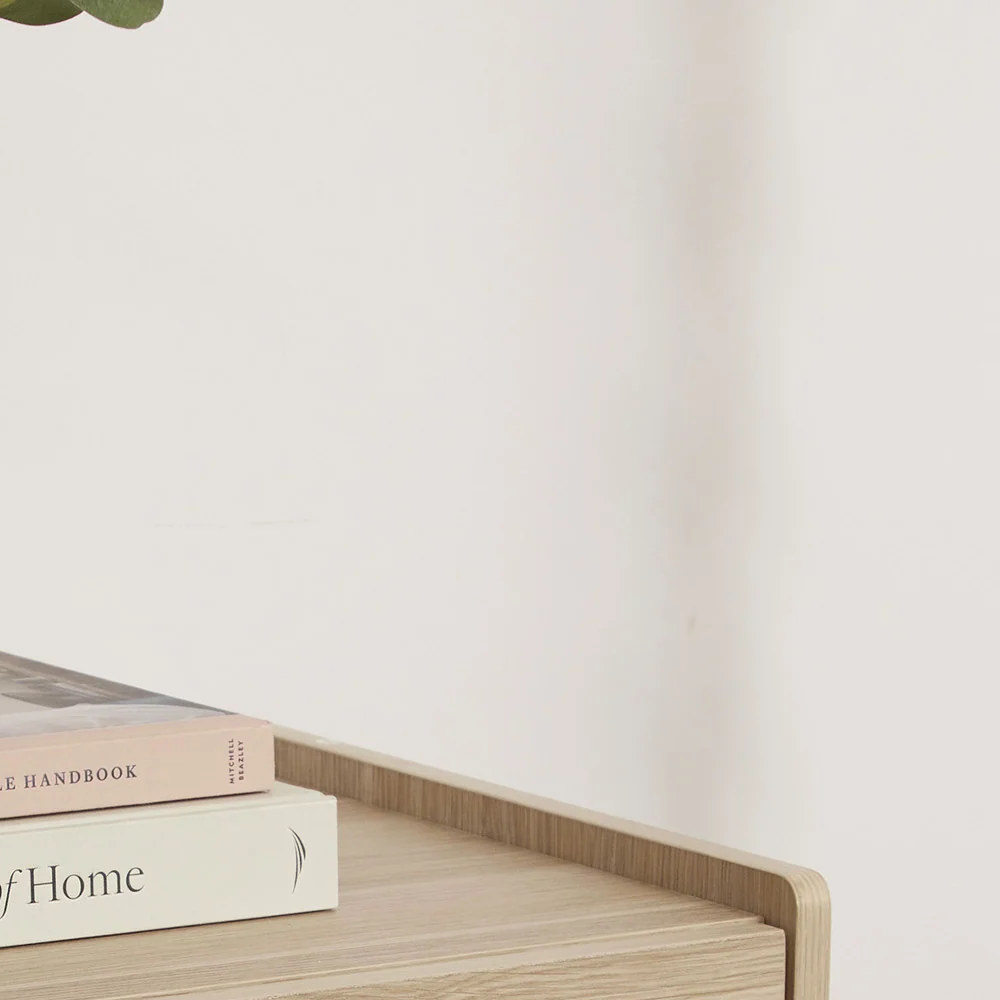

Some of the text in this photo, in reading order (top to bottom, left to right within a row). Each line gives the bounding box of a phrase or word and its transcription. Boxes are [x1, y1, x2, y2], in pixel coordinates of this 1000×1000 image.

[23, 764, 138, 789] HANDBOOK
[227, 738, 235, 785] MITCHELL
[237, 740, 245, 781] BEAZLEY
[26, 864, 145, 905] Home
